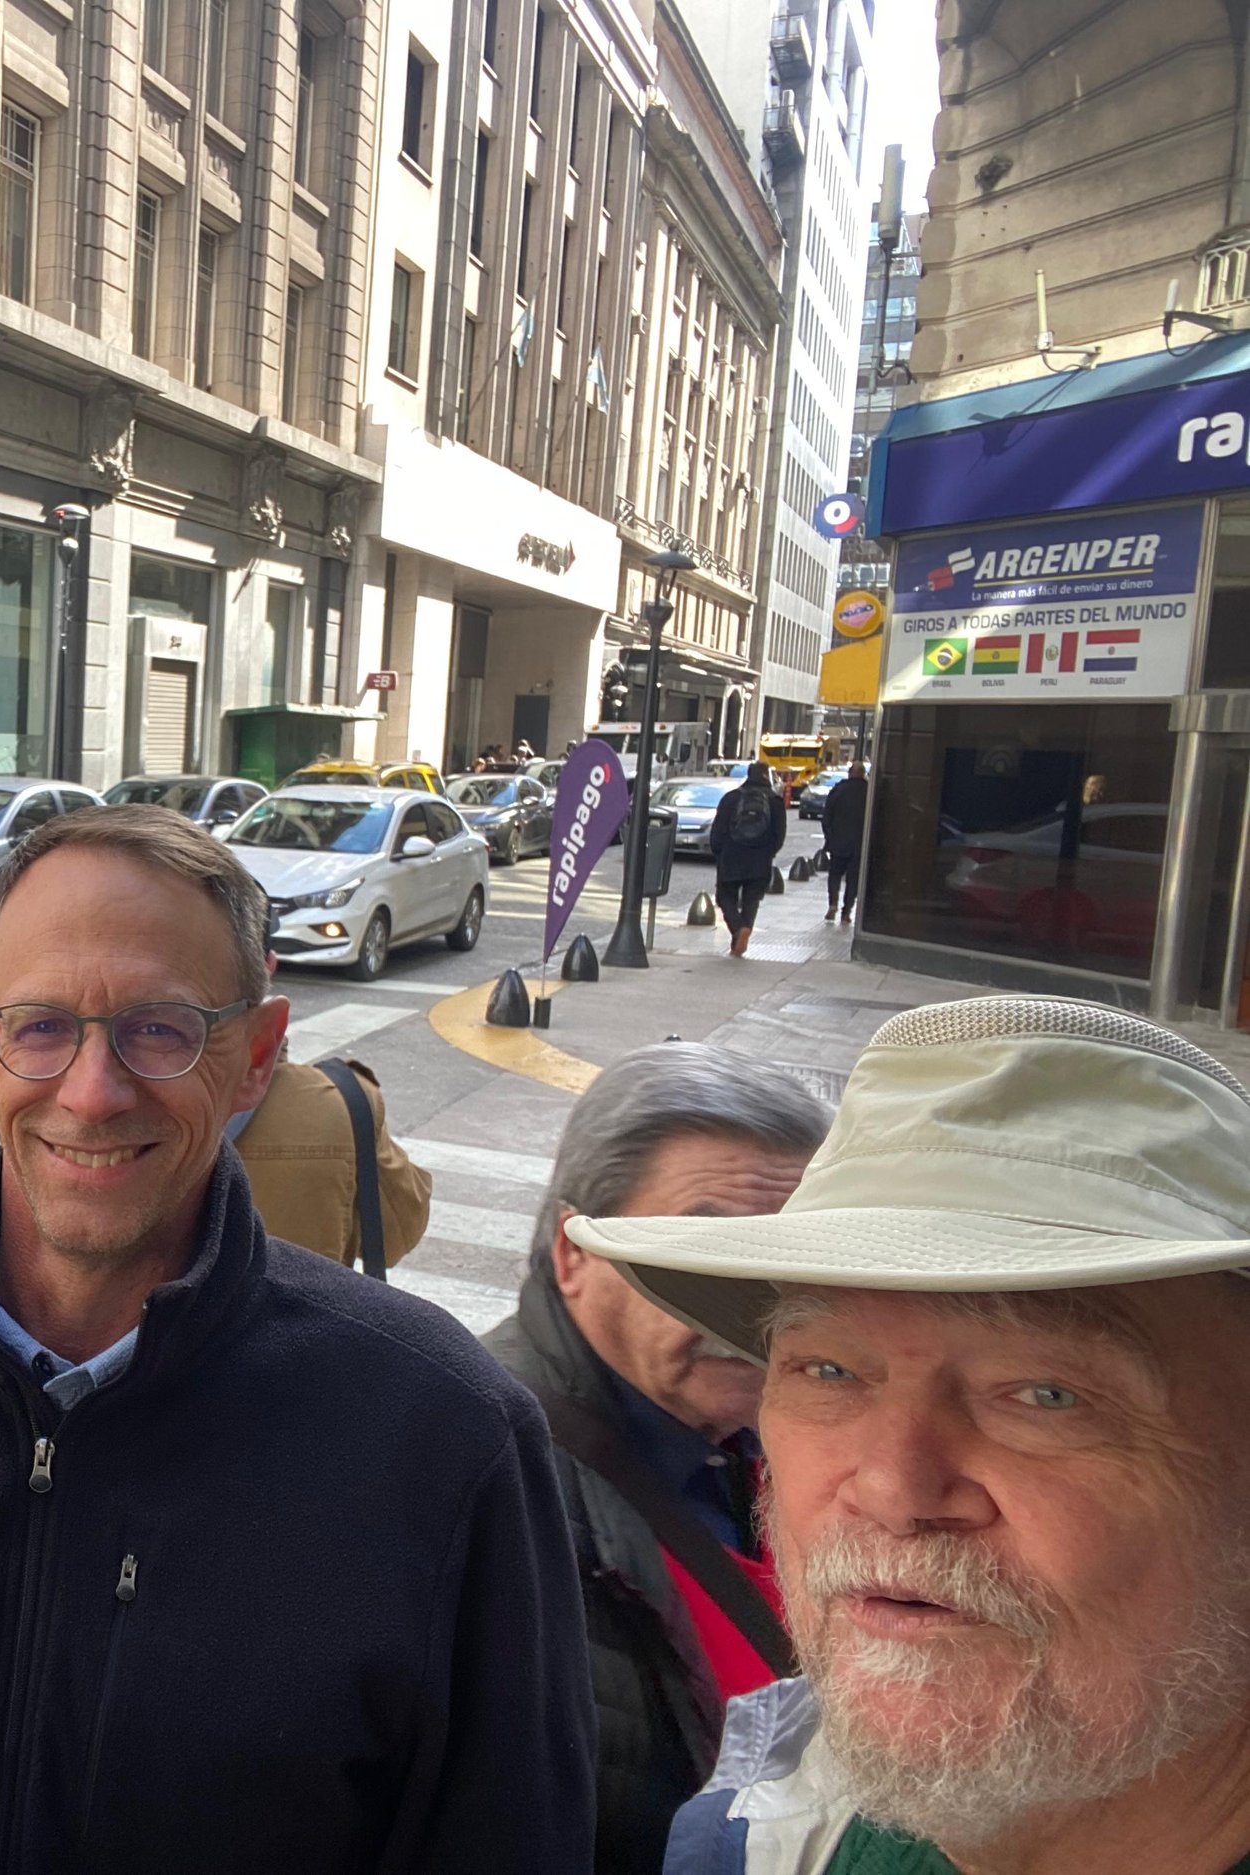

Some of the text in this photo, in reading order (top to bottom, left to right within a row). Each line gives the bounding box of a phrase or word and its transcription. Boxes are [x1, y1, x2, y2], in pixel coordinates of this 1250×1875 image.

[1178, 411, 1250, 467] ra
[973, 534, 1161, 580] ARGENPER
[972, 578, 1154, 601] La manera más fácil de enviar su dinero
[903, 602, 1187, 633] GIROS A TODAS PARTES DEL MUNDO
[552, 765, 606, 907] rapipago
